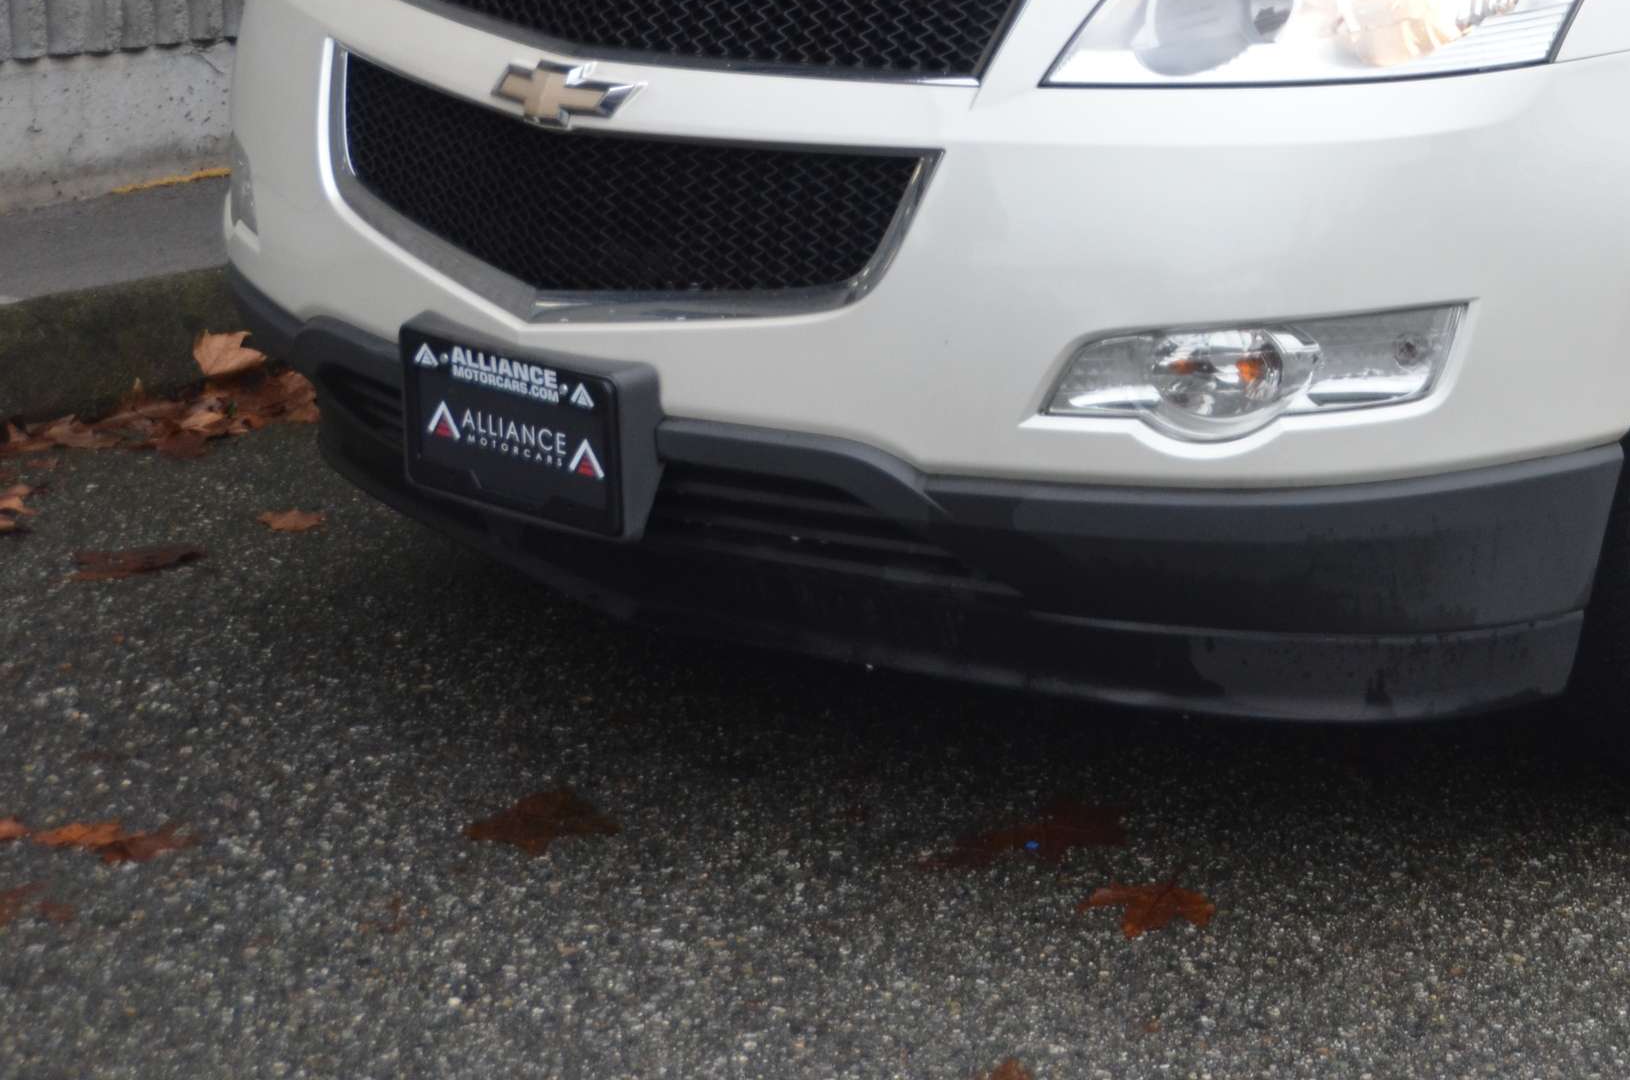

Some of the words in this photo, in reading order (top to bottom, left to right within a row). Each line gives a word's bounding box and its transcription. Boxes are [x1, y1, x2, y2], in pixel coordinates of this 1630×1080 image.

[451, 346, 558, 389] ALLIANCE
[452, 365, 560, 403] MOTORCARS.COM
[462, 408, 567, 455] ALLIANCE
[467, 434, 563, 467] MOTORCARS
